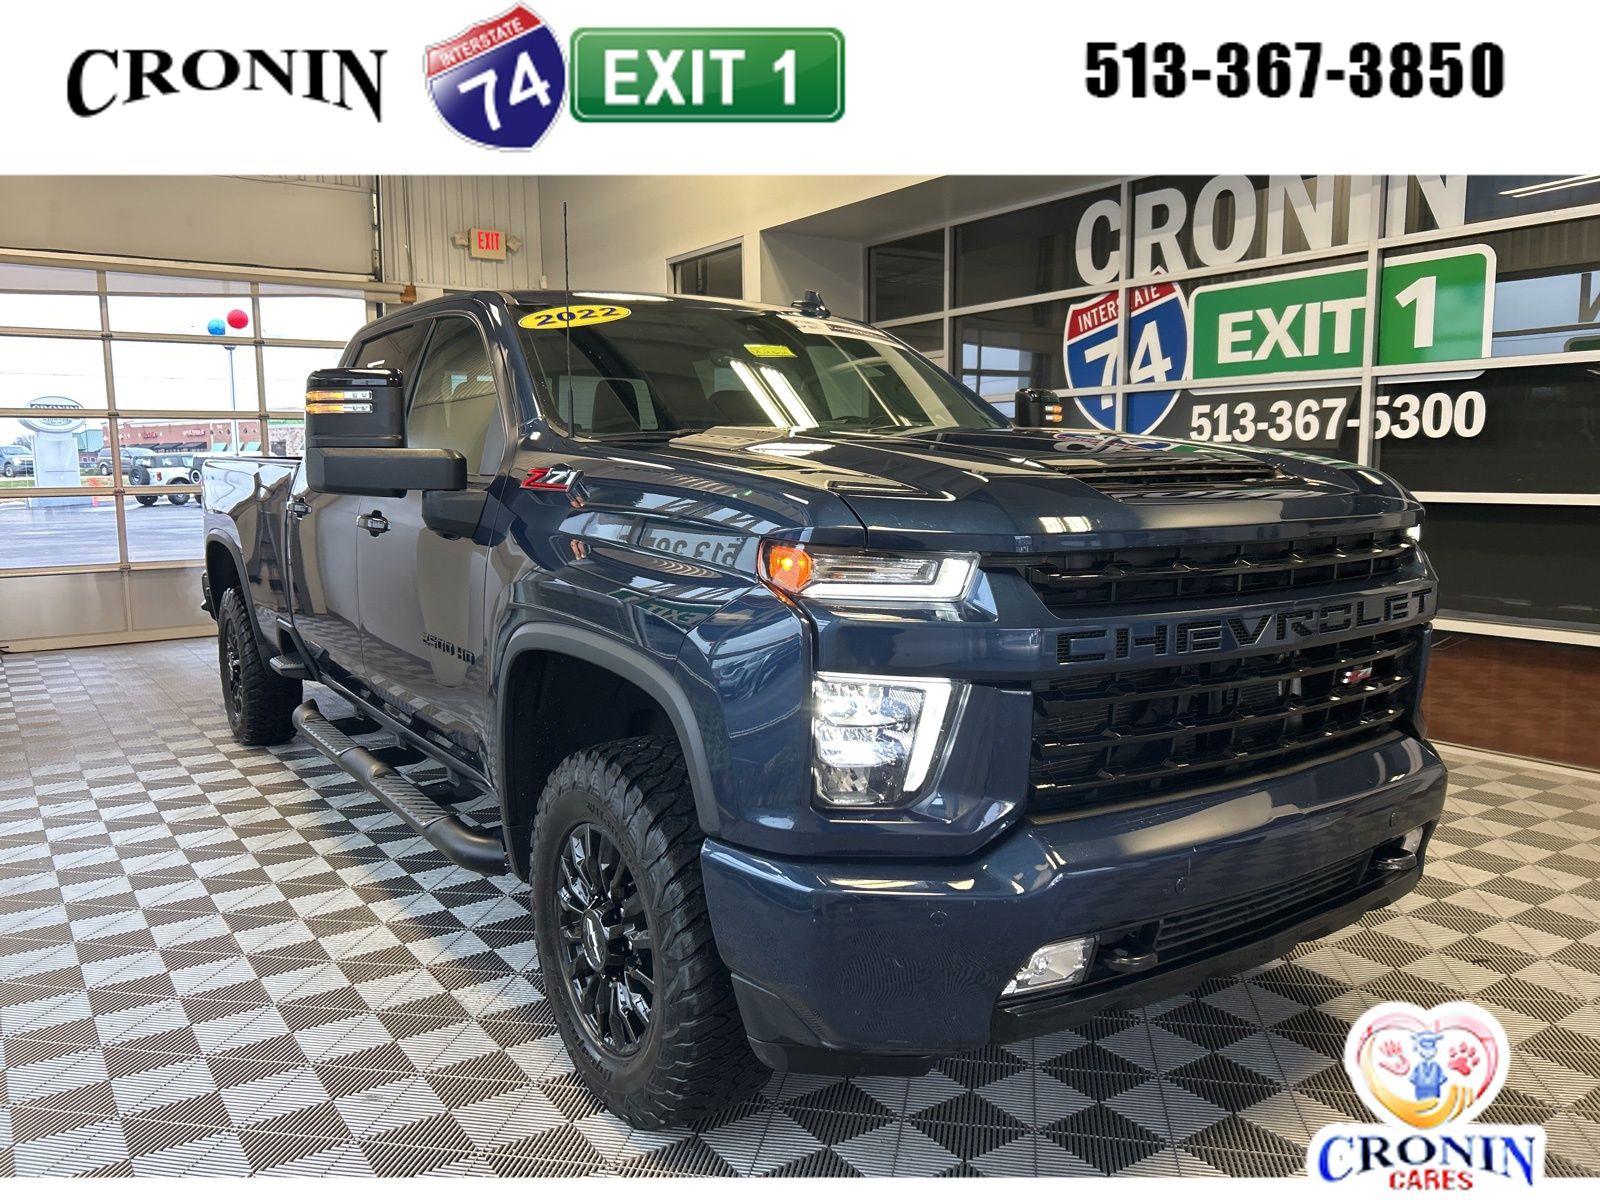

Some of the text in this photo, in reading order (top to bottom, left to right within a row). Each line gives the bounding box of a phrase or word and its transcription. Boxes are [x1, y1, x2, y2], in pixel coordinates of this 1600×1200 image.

[477, 230, 500, 251] EXIT
[1075, 174, 1467, 287] CRONIN
[534, 306, 621, 328] 2022
[1077, 285, 1161, 332] INTERATE
[1217, 275, 1437, 365] EXIT 1
[1083, 319, 1173, 411] 74
[1189, 390, 1487, 443] 513-367-5300
[1056, 586, 1432, 665] CHEVROLET
